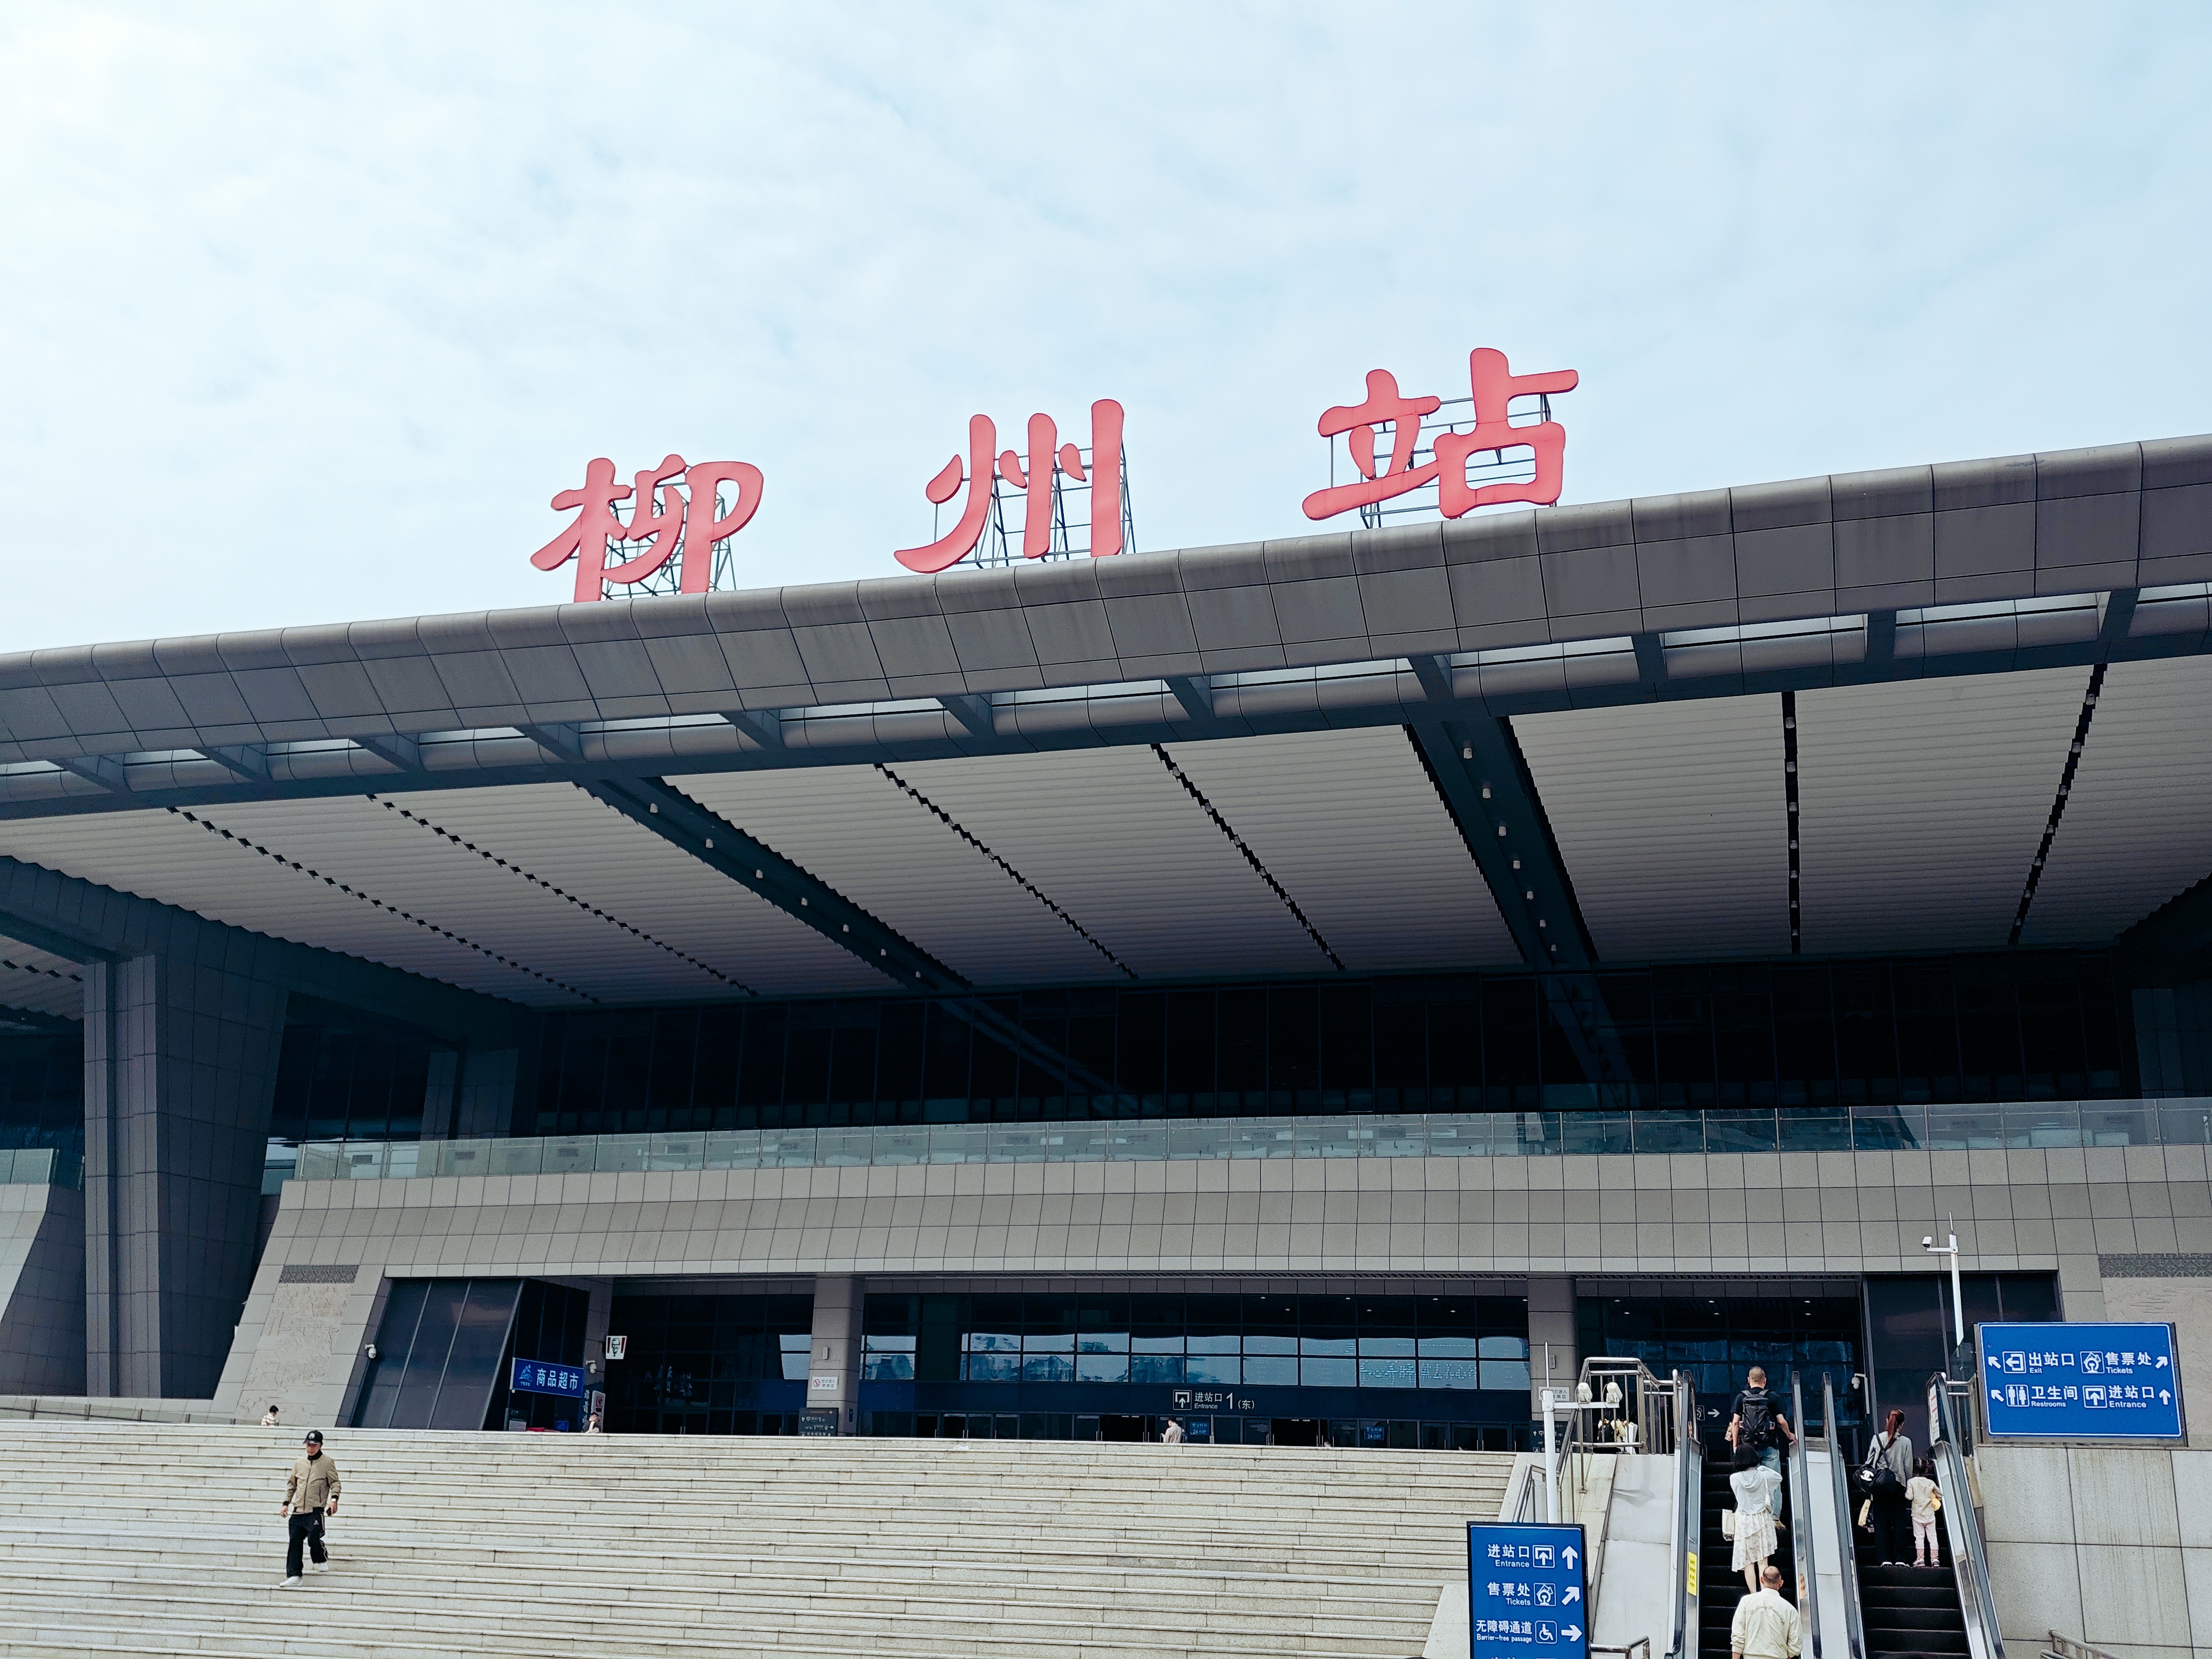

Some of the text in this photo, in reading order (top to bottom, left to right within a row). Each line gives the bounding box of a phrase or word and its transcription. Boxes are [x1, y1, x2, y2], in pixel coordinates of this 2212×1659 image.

[531, 348, 1578, 602] 柳州站
[2029, 1352, 2074, 1367] 出站口
[2106, 1352, 2152, 1366] 售票处
[536, 1368, 579, 1391] 商品超市
[2031, 1386, 2078, 1401] 卫生间
[2108, 1385, 2154, 1399] 进站口
[1195, 1392, 1255, 1410] 进站口 1 (东)
[1488, 1544, 1529, 1558] 进站口
[1487, 1582, 1530, 1596] 售票处
[1476, 1620, 1532, 1635] 无障碍通道
